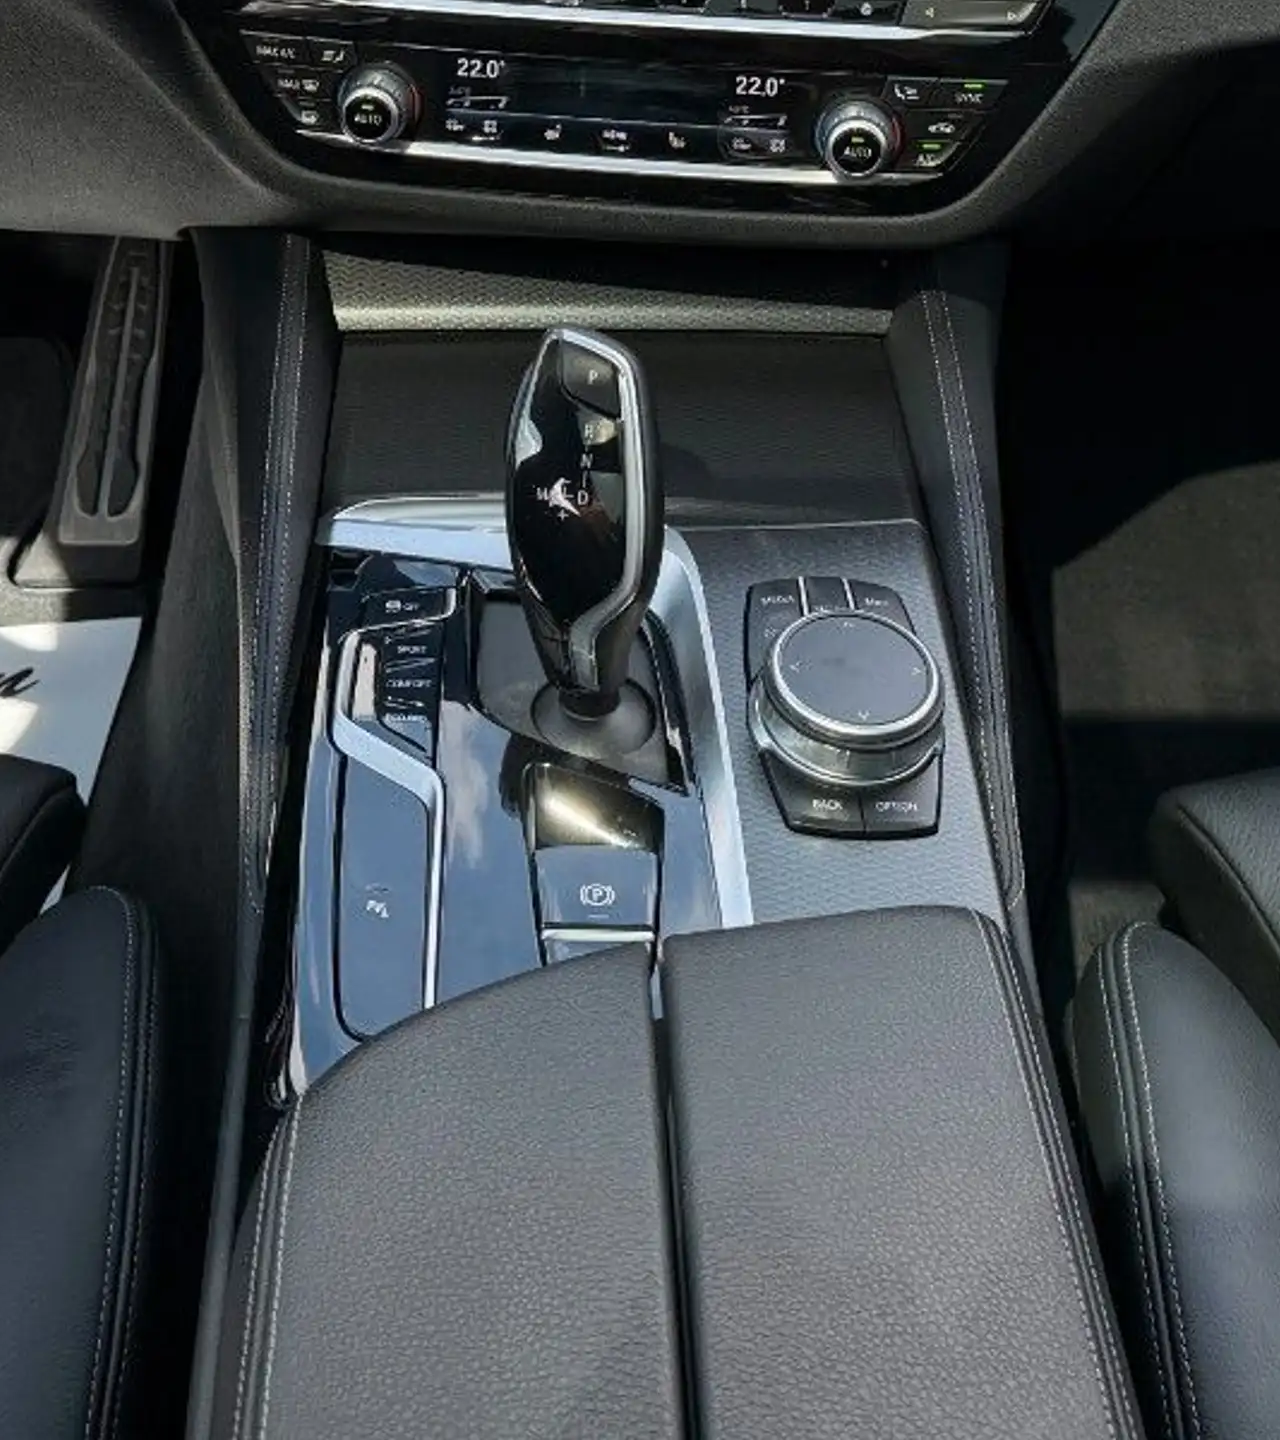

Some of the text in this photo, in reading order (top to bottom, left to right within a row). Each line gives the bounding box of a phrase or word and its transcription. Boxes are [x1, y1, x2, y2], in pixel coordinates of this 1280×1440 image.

[354, 114, 382, 126] AUTO
[843, 145, 872, 159] AUTO
[587, 369, 598, 385] P
[581, 453, 593, 468] N
[577, 489, 589, 506] D
[396, 644, 429, 655] SPORT
[385, 678, 433, 689] COMFORT
[812, 798, 918, 813] BACK OPTION
